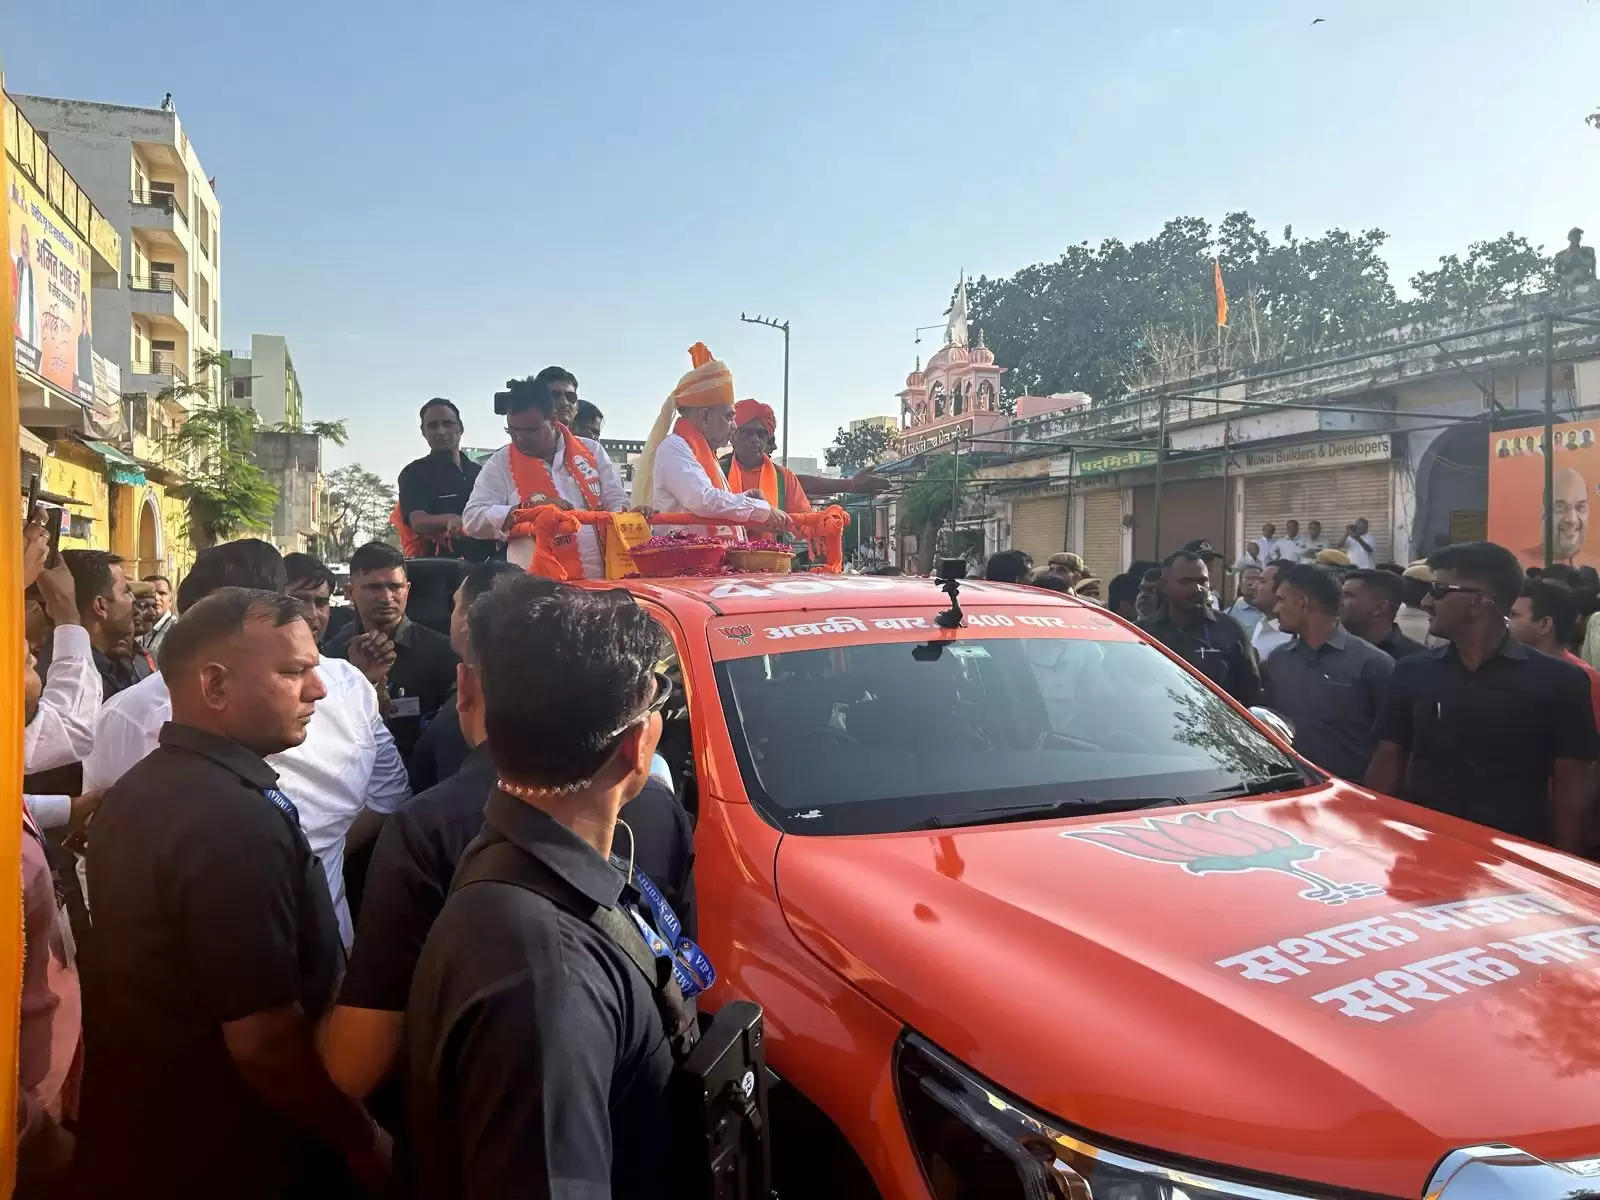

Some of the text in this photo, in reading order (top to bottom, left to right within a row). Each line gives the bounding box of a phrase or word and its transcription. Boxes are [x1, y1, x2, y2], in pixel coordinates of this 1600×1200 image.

[1276, 448, 1316, 464] Builders
[1318, 444, 1326, 458] &
[1328, 438, 1389, 458] Developers
[763, 616, 869, 640] अबकी
[967, 614, 1015, 627] 400
[663, 912, 678, 932] VIP
[1215, 915, 1420, 984] सशक्त
[696, 955, 710, 973] VIP
[1311, 946, 1520, 1023] सशक्त
